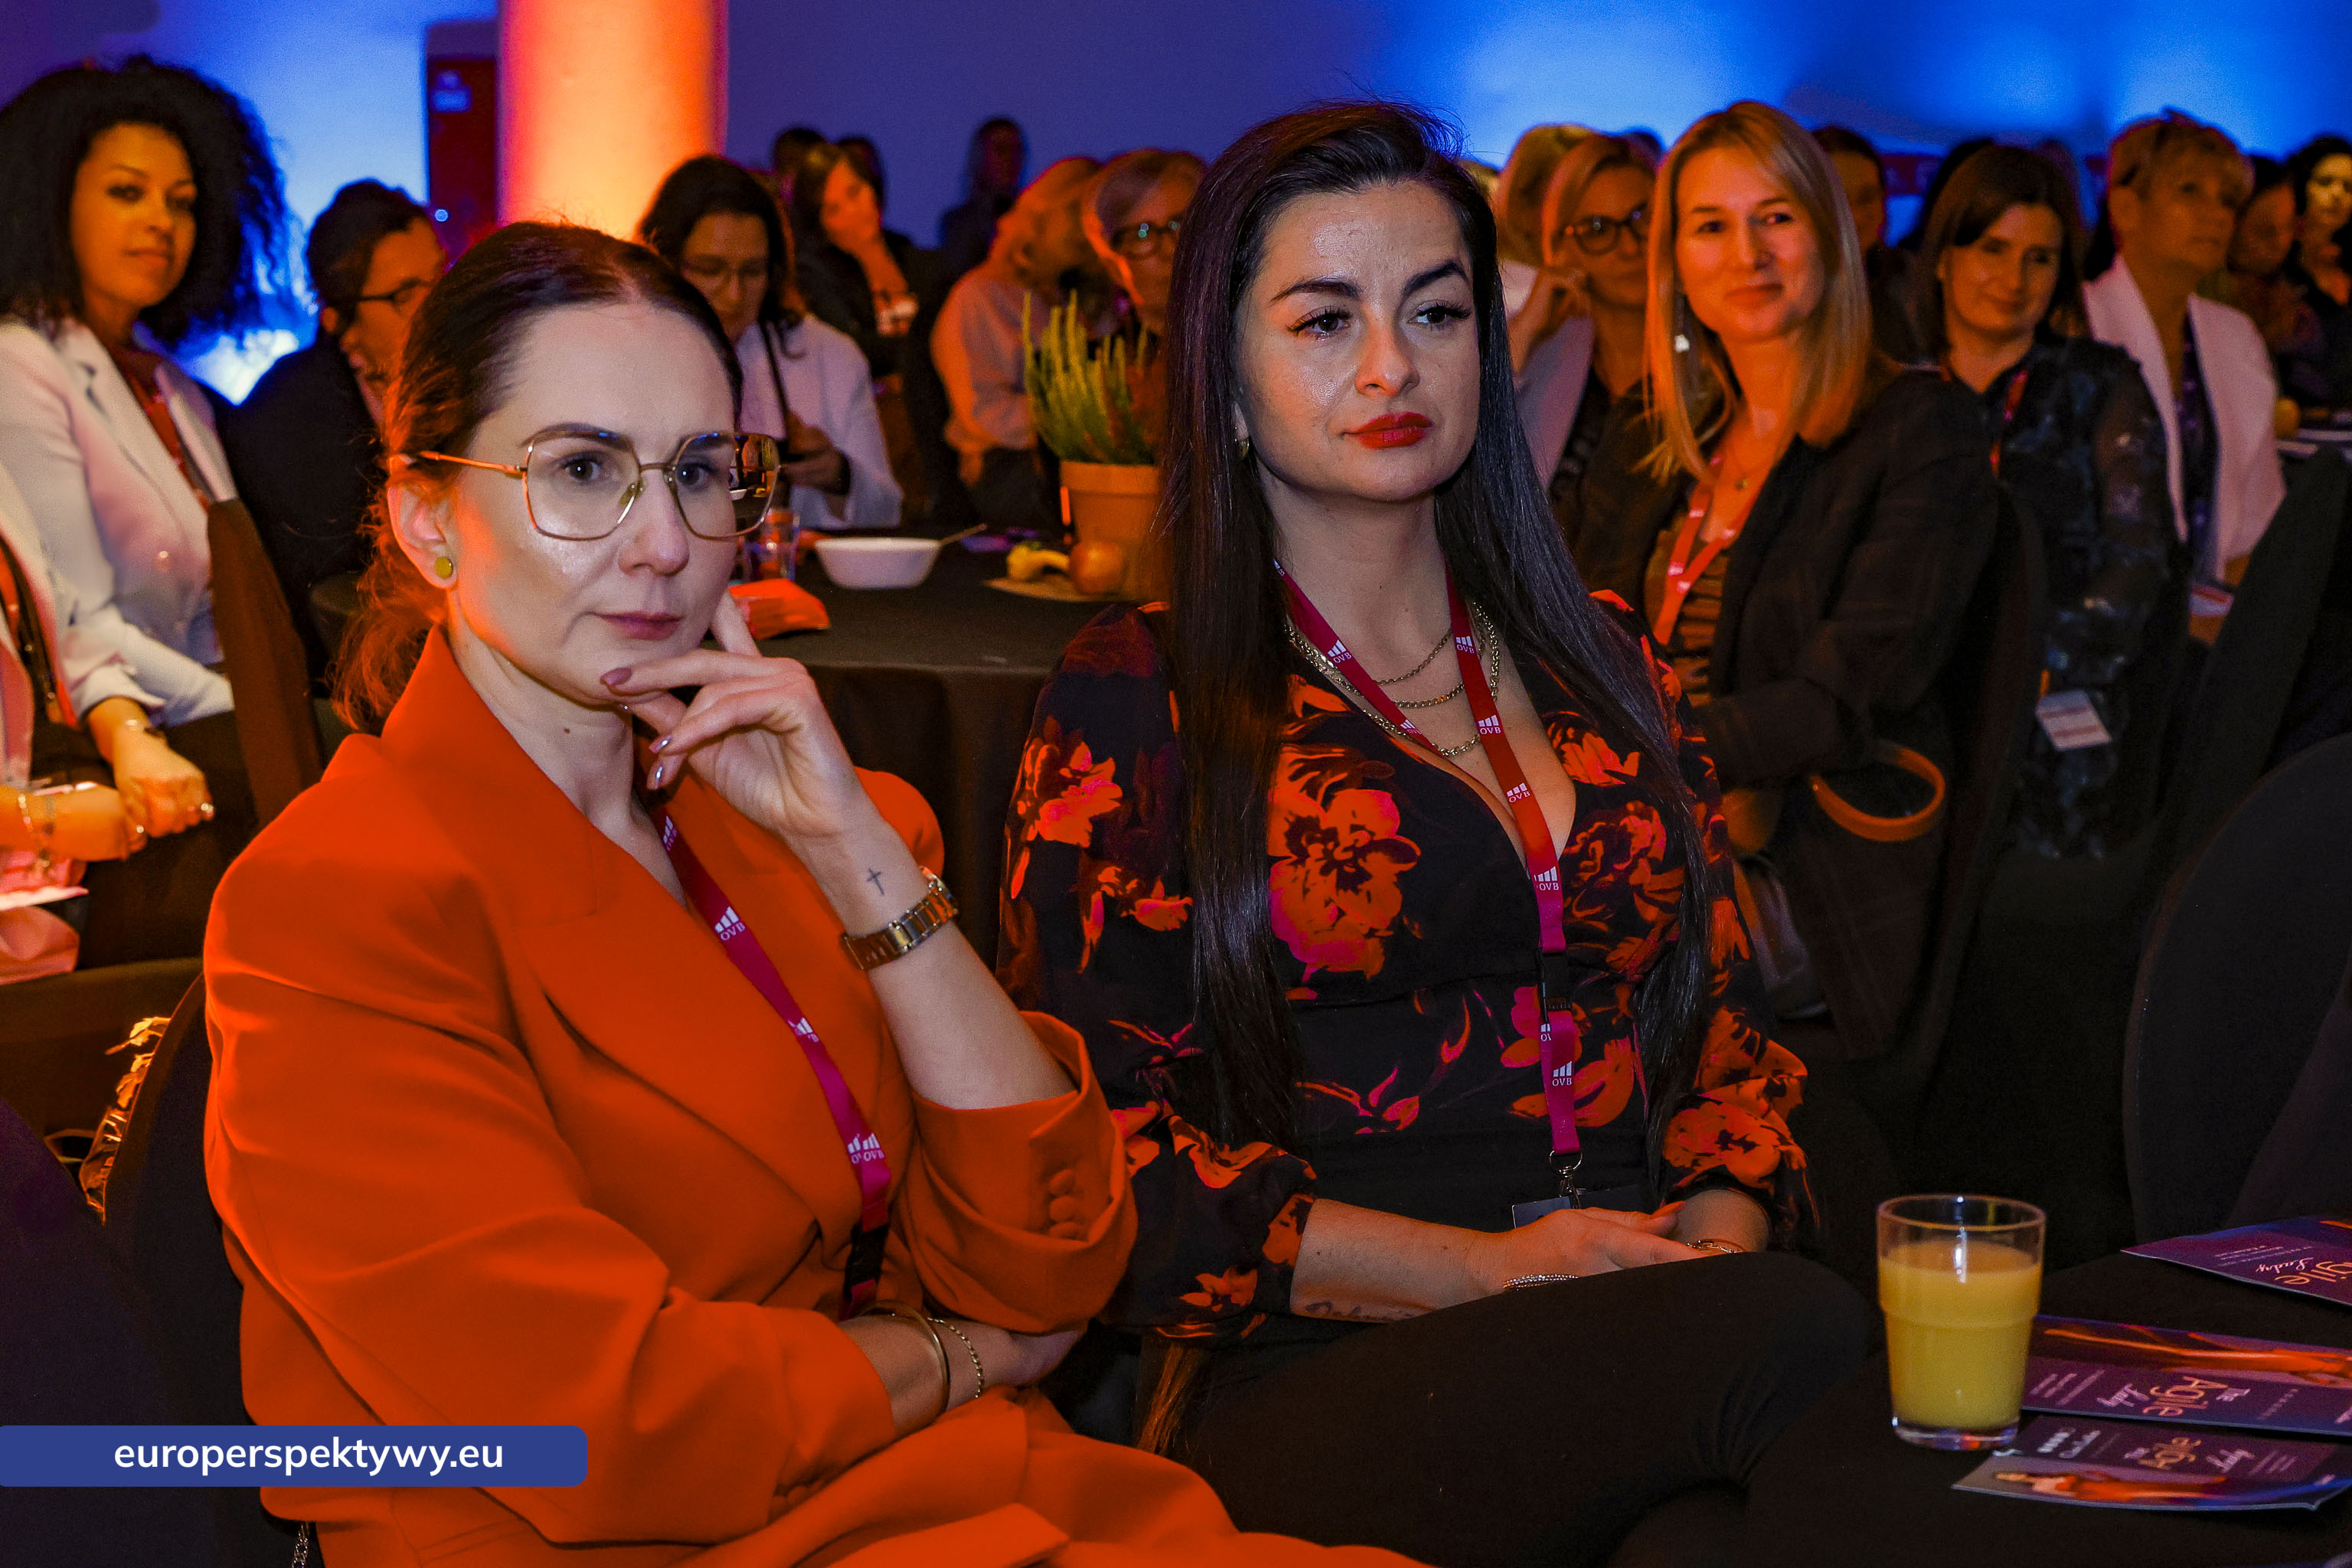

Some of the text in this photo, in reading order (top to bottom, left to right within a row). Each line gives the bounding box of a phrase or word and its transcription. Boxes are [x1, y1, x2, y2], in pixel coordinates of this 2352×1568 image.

[1456, 643, 1475, 655] OVB
[1333, 652, 1352, 664] OVB
[1479, 726, 1501, 735] OVB
[1508, 790, 1530, 803] OVB
[1539, 883, 1560, 891] OVB
[720, 922, 746, 941] OVB
[1552, 1078, 1573, 1086] OVB
[864, 1149, 885, 1162] OVB
[2274, 1260, 2352, 1285] gile
[2142, 1376, 2229, 1416] Agile
